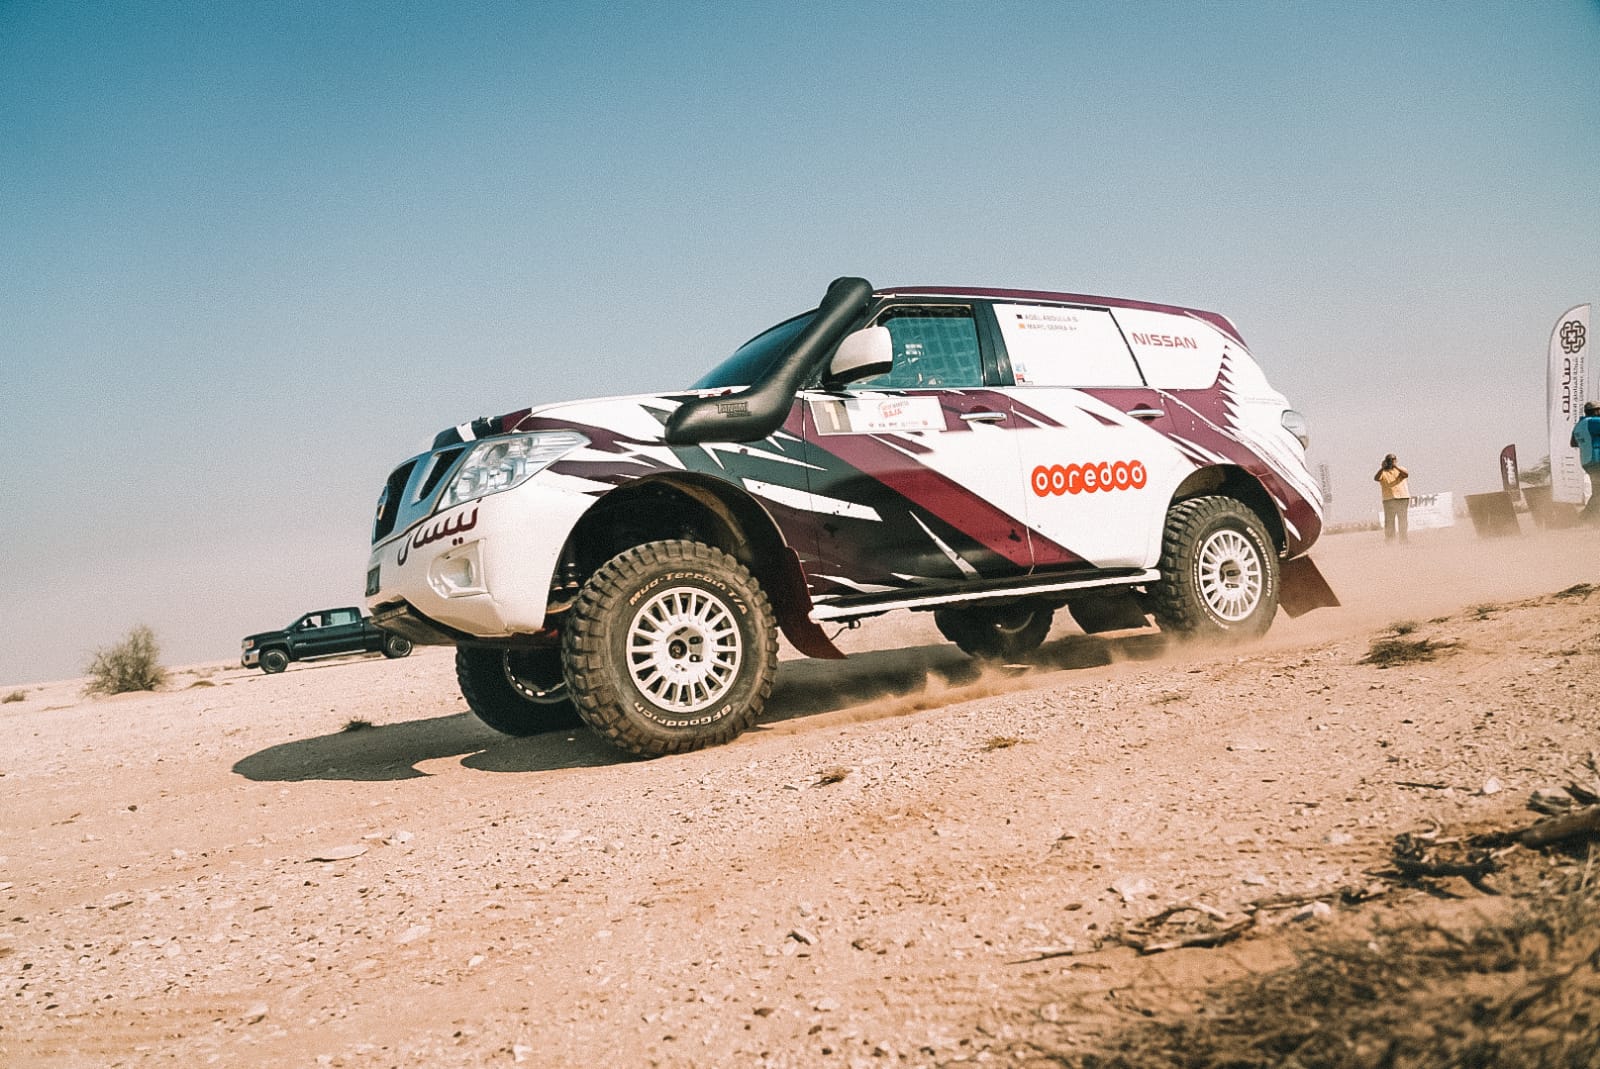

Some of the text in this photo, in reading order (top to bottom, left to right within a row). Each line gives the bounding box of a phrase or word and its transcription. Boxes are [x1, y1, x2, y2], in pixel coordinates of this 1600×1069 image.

[1131, 332, 1198, 349] NISSAN
[823, 401, 841, 431] 1
[1034, 461, 1145, 492] ooredoo
[397, 497, 482, 566] نيسان
[634, 702, 732, 727] BFGoodrich
